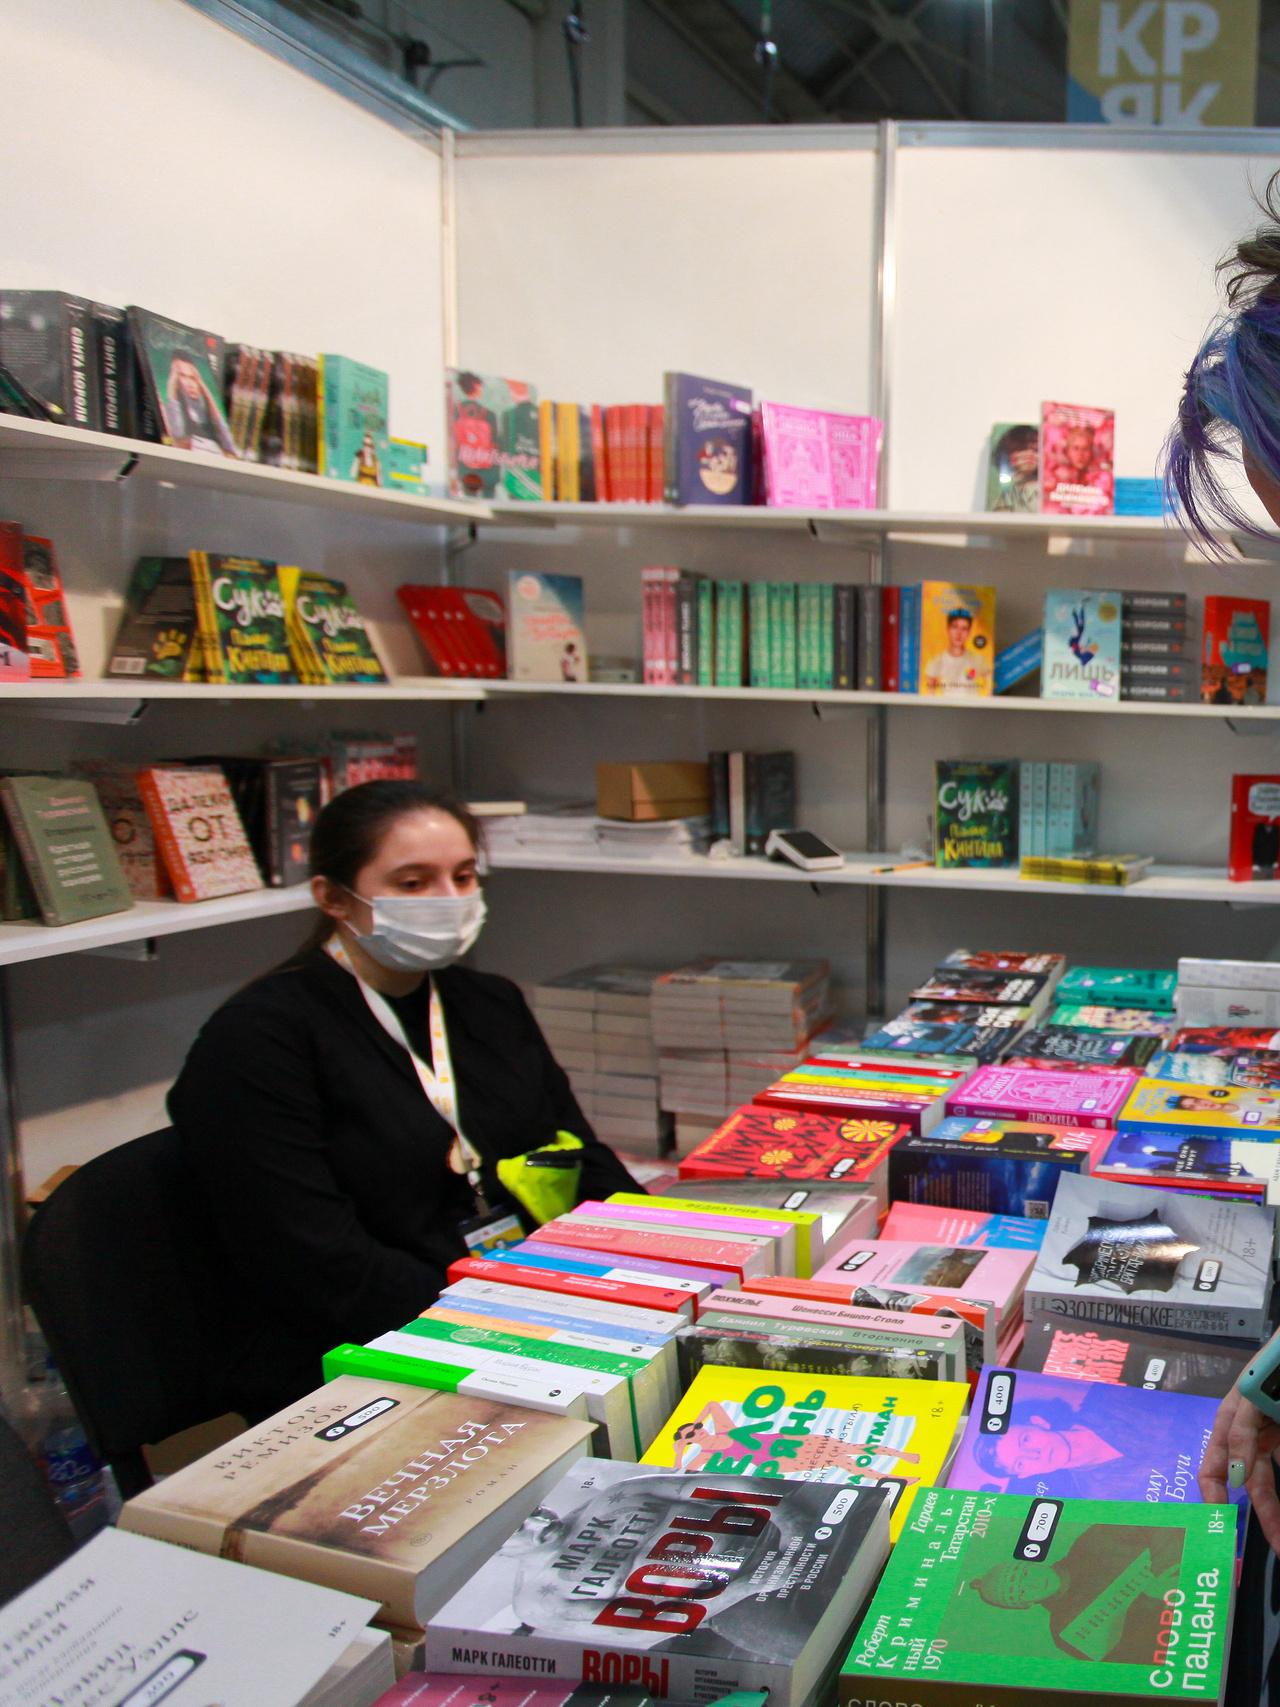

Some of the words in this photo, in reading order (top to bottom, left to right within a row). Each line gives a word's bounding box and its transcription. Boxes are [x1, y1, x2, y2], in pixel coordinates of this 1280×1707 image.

[1098, 0, 1220, 77] КР
[1050, 662, 1114, 683] ЛИШЬ
[188, 814, 228, 842] ОТ
[1243, 1238, 1257, 1258] 18+
[711, 1294, 764, 1308] ПОХМЕЛЬЕ
[791, 1304, 837, 1317] Шонесси
[838, 1311, 905, 1325] Бишоп-Столл
[717, 1316, 766, 1328] Даниил
[774, 1321, 844, 1337] Туровский
[852, 1331, 924, 1345] Вторжение
[357, 1405, 381, 1421] 500
[931, 1400, 944, 1419] 18+
[994, 1385, 1005, 1405] 400
[213, 1405, 319, 1470] ВИКТОР
[223, 1403, 348, 1480] РЕМИЗОВ
[703, 1385, 785, 1475] ЕЛО
[753, 1390, 826, 1479] РЯНЬ
[856, 1397, 898, 1467] ОЛТМАН
[338, 1419, 491, 1523] ВЕЧНАЯ
[804, 1428, 835, 1482] ОНЕСЕНИЯ
[815, 1459, 834, 1483] ОНТА
[360, 1420, 527, 1537] МЕРЗЛОТА
[465, 1463, 519, 1504] РОМАН
[581, 1477, 595, 1490] 18+
[1146, 1469, 1169, 1503] ему
[1165, 1454, 1194, 1501] Боуи
[832, 1497, 849, 1516] 500
[910, 1492, 939, 1534] Гараев
[969, 1497, 997, 1538] 2010-х
[1036, 1512, 1049, 1532] 700
[1208, 1509, 1225, 1534] 18+
[552, 1516, 617, 1570] МАРК
[572, 1501, 667, 1597] ГАЛЕОТТИ
[939, 1495, 978, 1563] Татарстан
[592, 1487, 784, 1636] ВОРЫ
[749, 1551, 777, 1585] ИСТОРИЯ
[756, 1535, 804, 1602] ОРГАНИЗОВАННОЙ
[777, 1543, 817, 1598] ПРЕСТУПНОСТИ
[804, 1553, 830, 1582] РОССИИ
[800, 1582, 811, 1591] В
[328, 1619, 346, 1638] 18+
[855, 1614, 891, 1668] Роберт
[452, 1648, 488, 1666] МАРК
[491, 1650, 556, 1674] ГАЛЕОТТИ
[582, 1649, 669, 1698] ВОРЫ
[903, 1637, 927, 1671] ный
[922, 1638, 948, 1671] 1970
